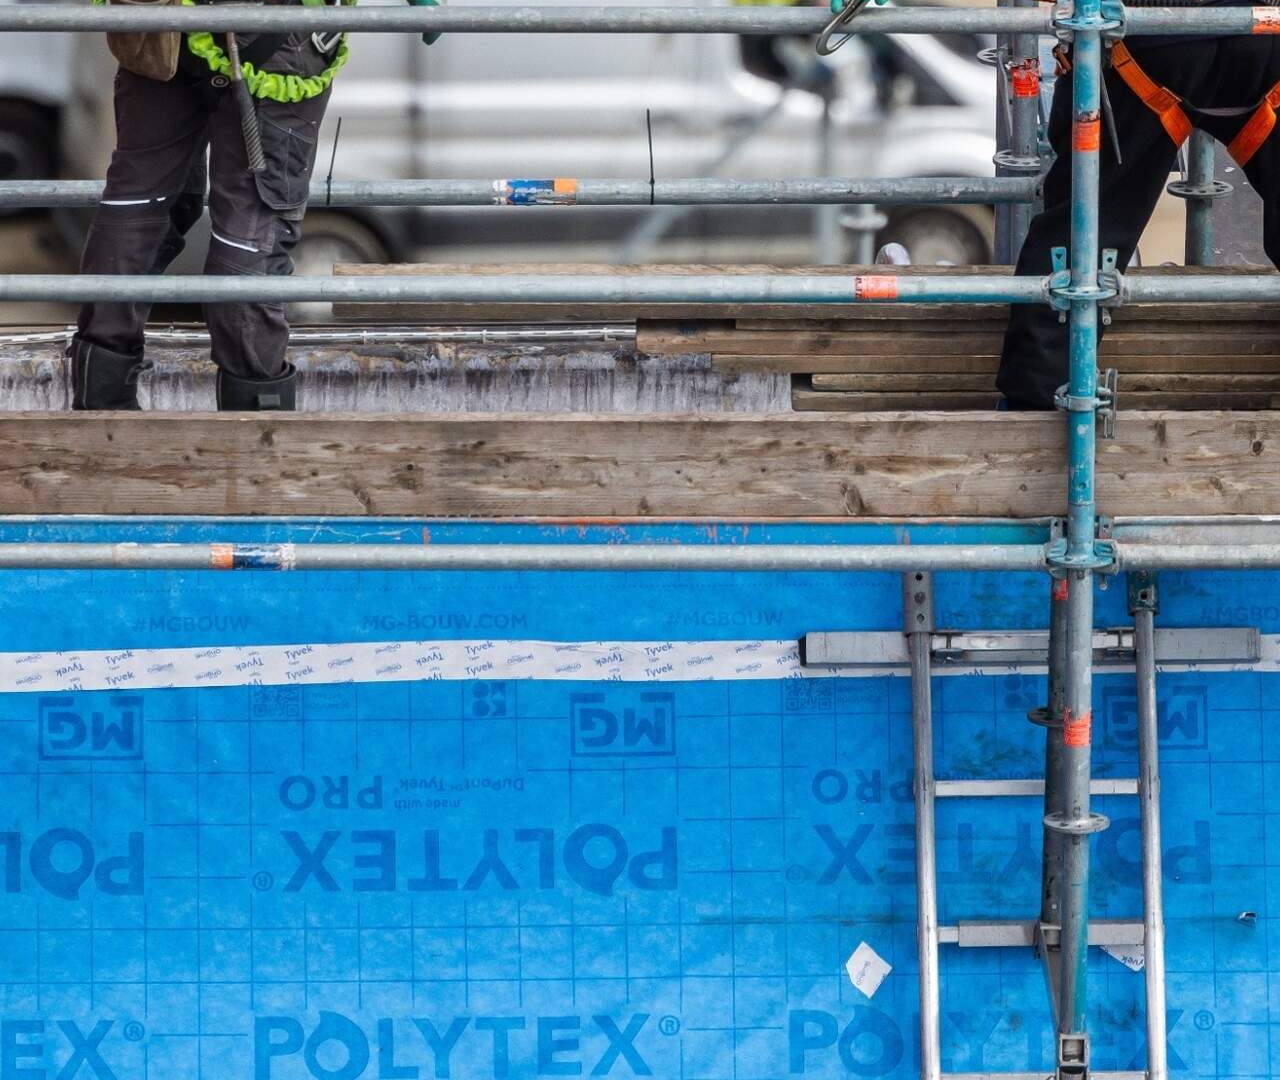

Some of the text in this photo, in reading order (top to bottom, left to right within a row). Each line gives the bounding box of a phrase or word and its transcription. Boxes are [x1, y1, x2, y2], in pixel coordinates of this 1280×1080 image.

[284, 645, 313, 660] Tyvek
[464, 641, 494, 656] Tyvek
[644, 642, 673, 657] Tyvek
[104, 651, 134, 665] Tyvek
[235, 657, 264, 671] Tyvek
[416, 652, 444, 666] Tyvek
[595, 652, 624, 667] Tyvek
[776, 651, 800, 665] yvek
[55, 663, 84, 677] Tyvek
[285, 665, 314, 680] Tyvek
[464, 661, 494, 676] Tyvek
[645, 662, 673, 677] Tyvek
[104, 671, 135, 686] Tyvek
[47, 713, 135, 752] MG
[579, 708, 667, 749] MG
[280, 775, 382, 811] PRO
[811, 768, 917, 804] PRO
[394, 799, 461, 811] made with
